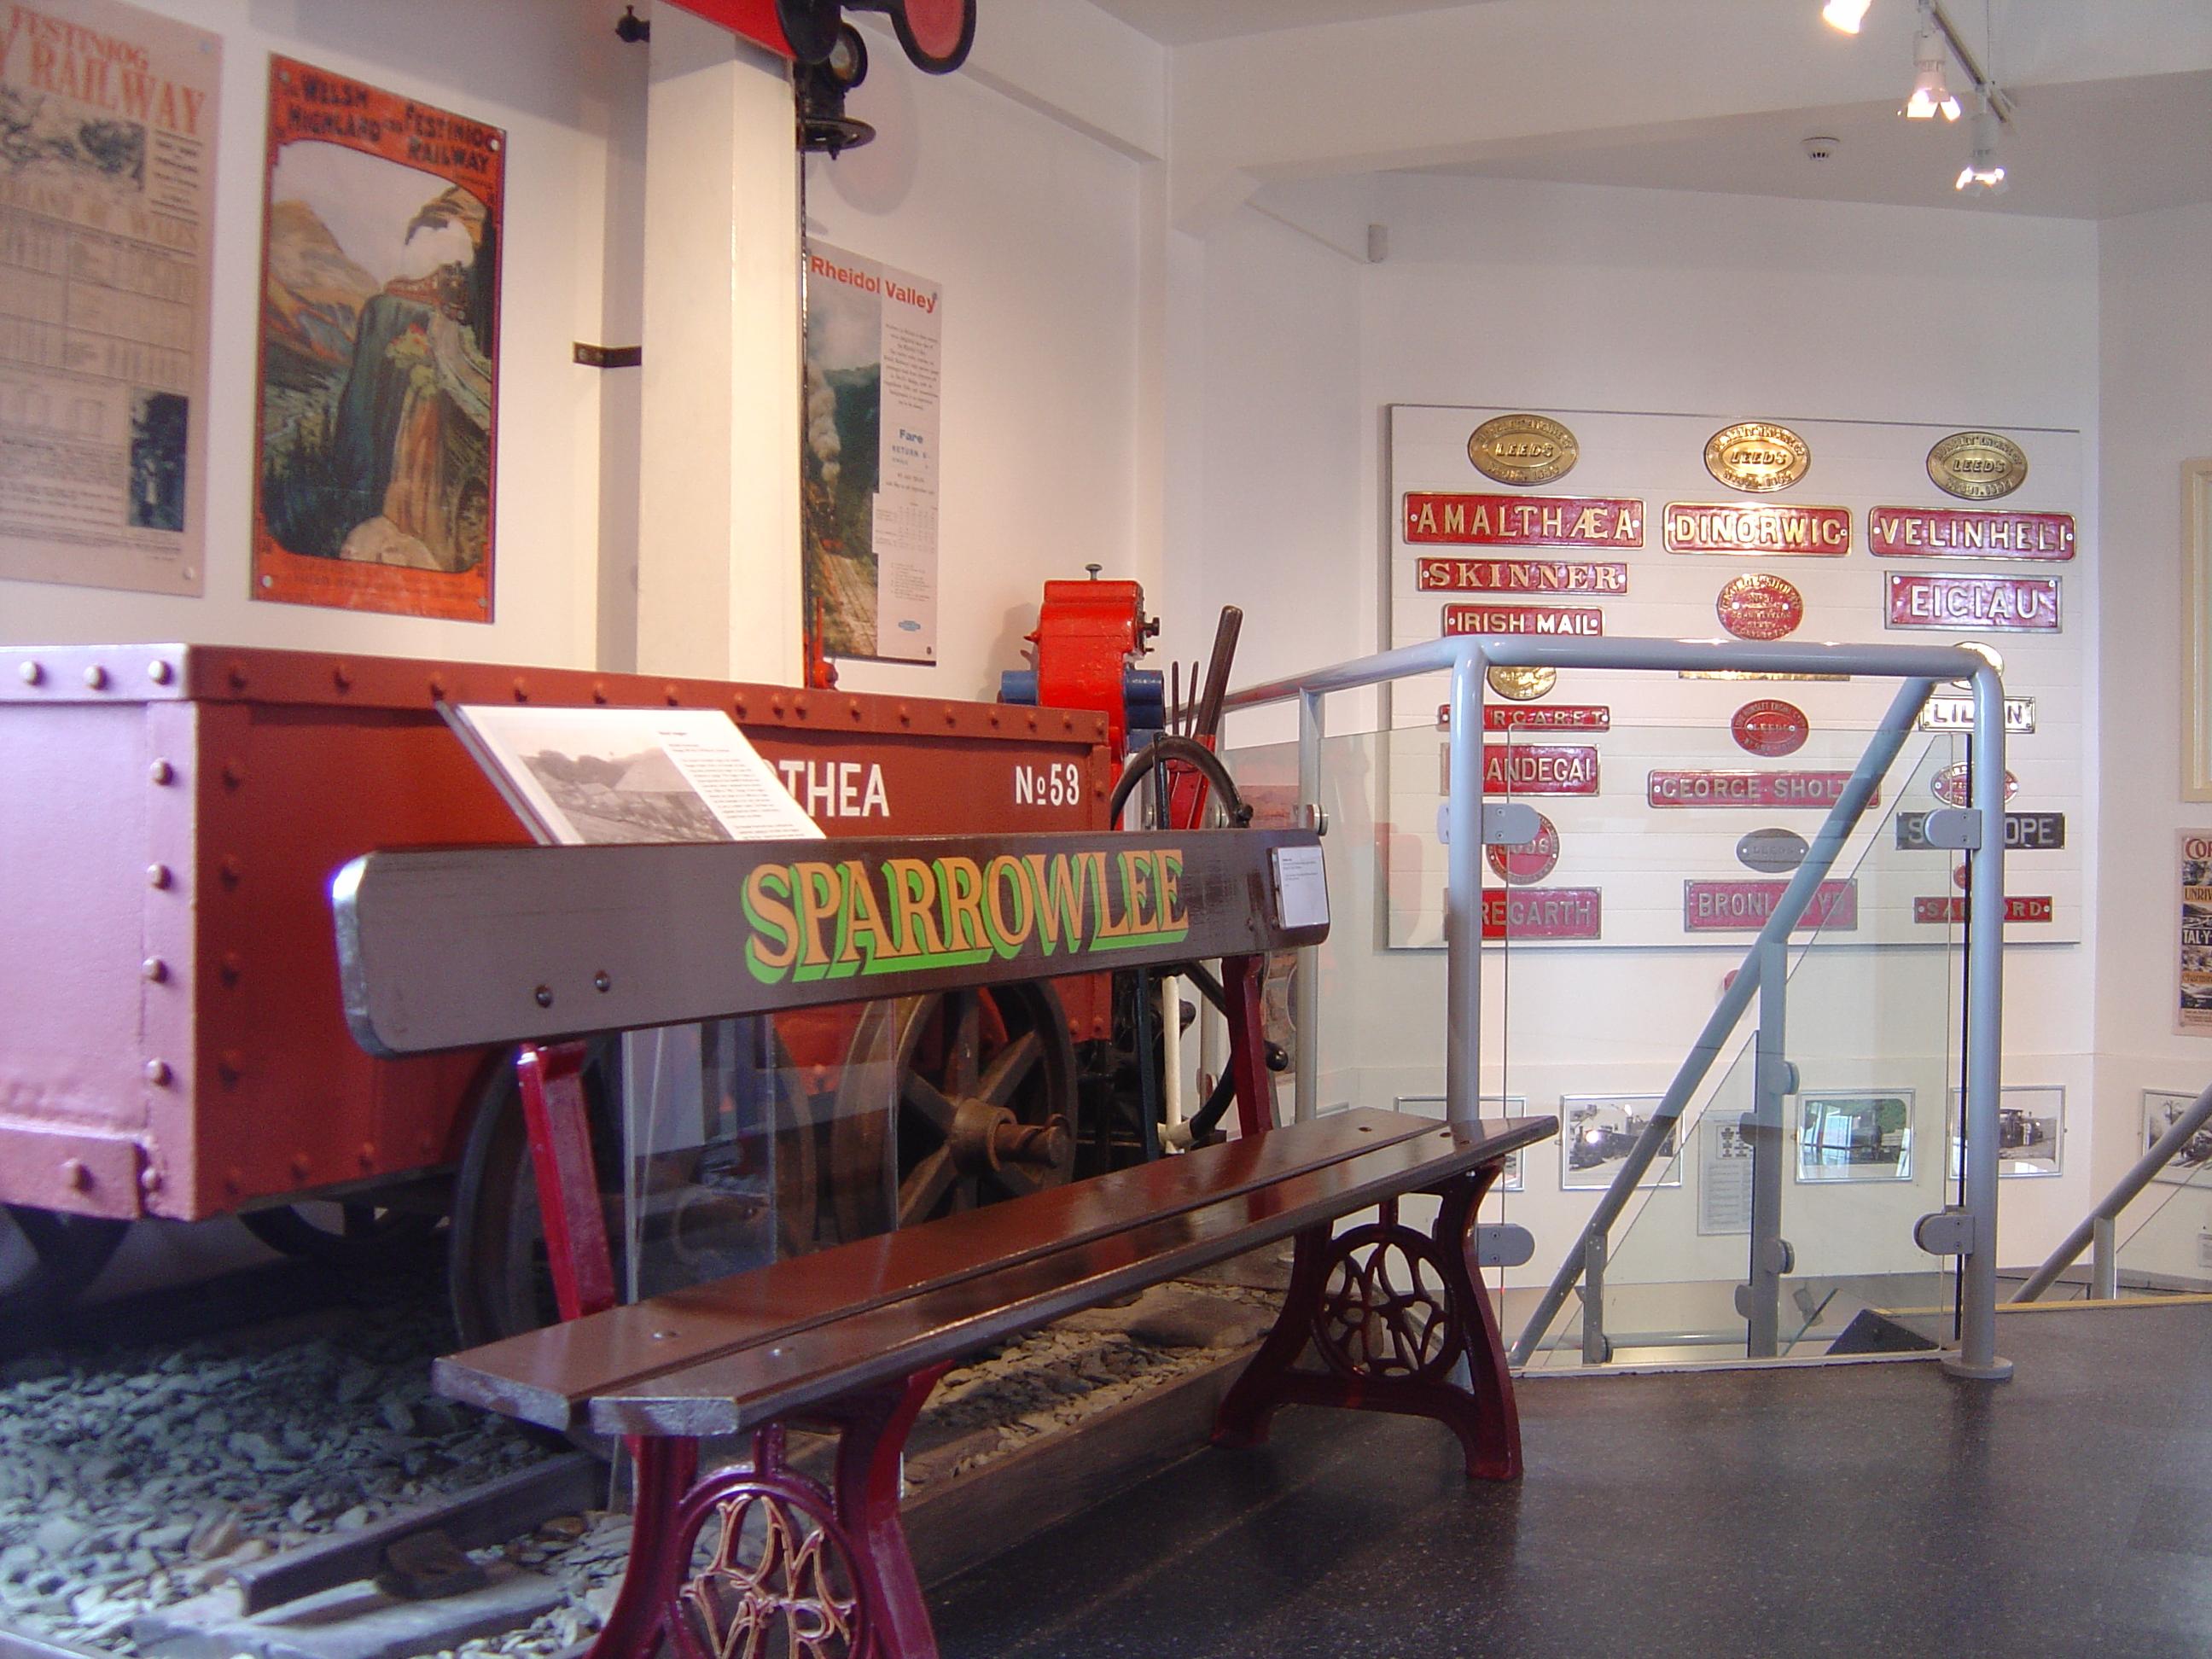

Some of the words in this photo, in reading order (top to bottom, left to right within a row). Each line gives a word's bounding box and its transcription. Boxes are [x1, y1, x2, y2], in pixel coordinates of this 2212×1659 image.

[30, 39, 206, 135] RAILWAY
[811, 255, 881, 294] Rheidol
[885, 279, 937, 314] Valley
[899, 428, 924, 445] Fare
[1495, 443, 1554, 457] LEEDS
[1731, 450, 1788, 465] LEEDS
[1952, 457, 2006, 473] LEEDS
[1675, 515, 1842, 544] DINORWIC
[1879, 517, 2065, 551] VELINHELI
[1429, 562, 1620, 588] SKINNER
[1456, 612, 1525, 634] IRISH
[1537, 614, 1599, 636] MAIL
[1493, 709, 1602, 725] RGARET
[1933, 704, 2023, 724] LILN
[1486, 756, 1592, 783] ANDEGAI
[765, 759, 890, 818] THEA
[1662, 778, 1761, 799] GEORGE
[1773, 779, 1850, 800] SHOLT
[1908, 816, 2054, 845] SOPE
[740, 849, 1190, 985] SPARROWLEE
[1481, 900, 1593, 926] REGARTH
[1697, 891, 1844, 918] BRONLYD
[1927, 901, 2042, 917] SARD
